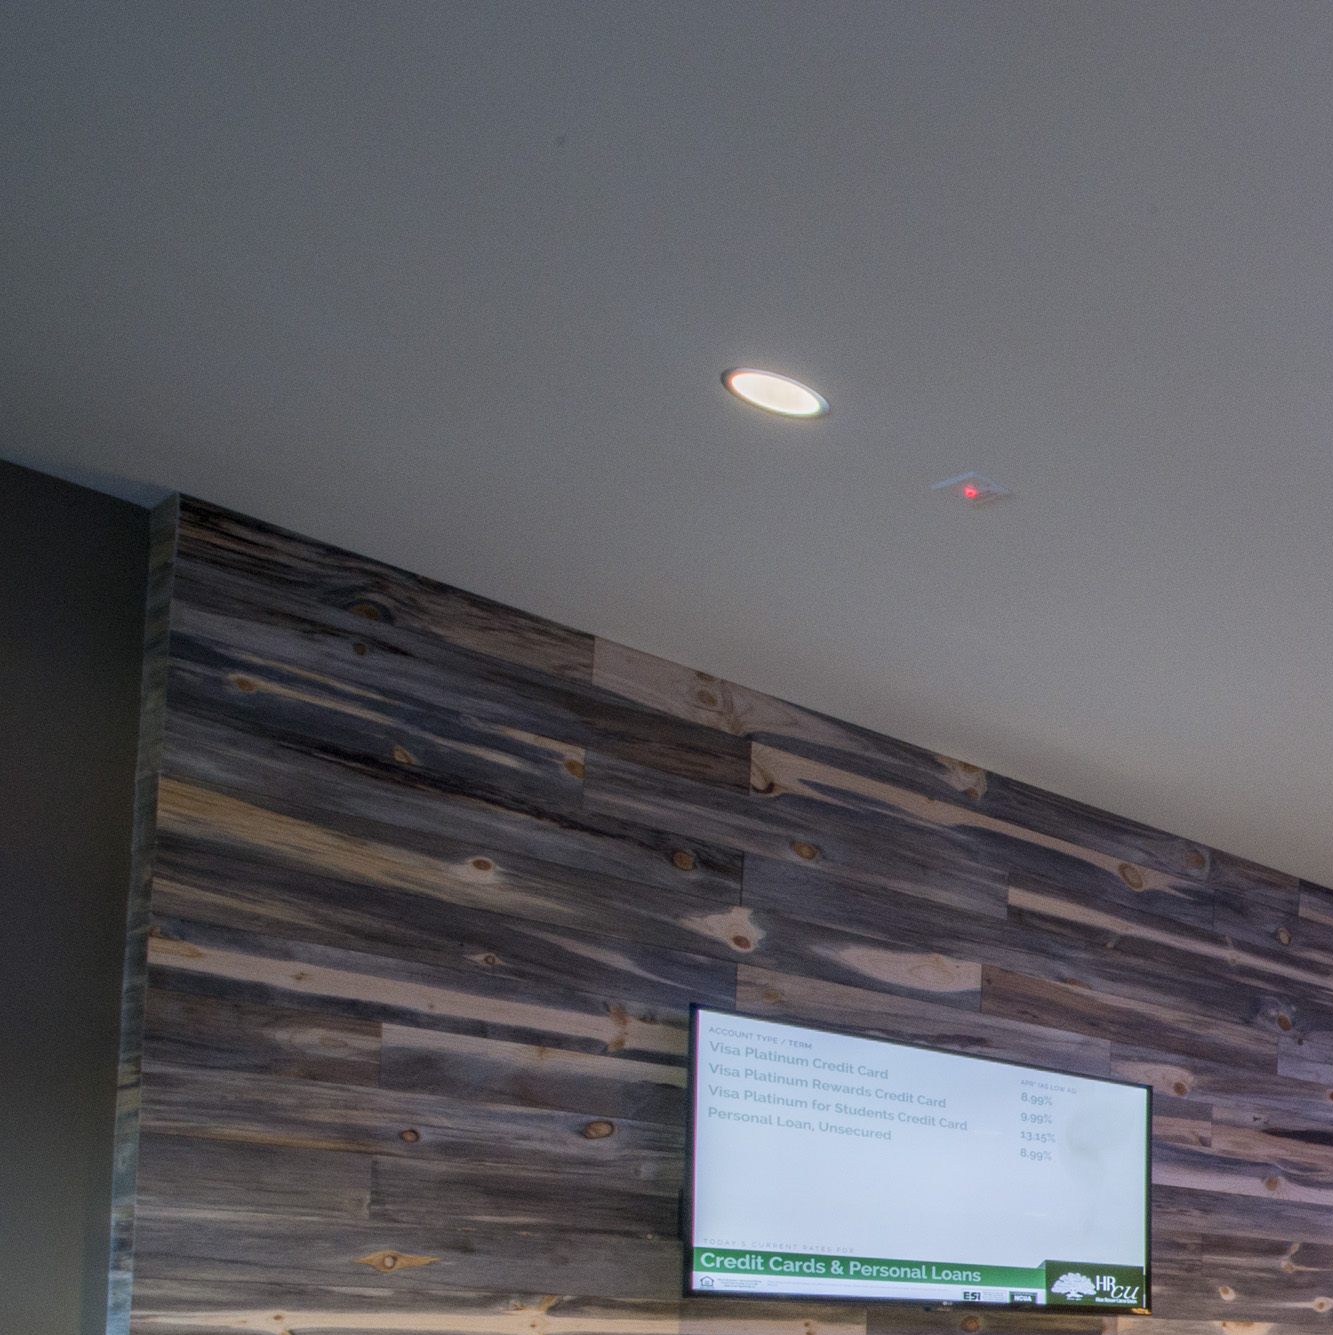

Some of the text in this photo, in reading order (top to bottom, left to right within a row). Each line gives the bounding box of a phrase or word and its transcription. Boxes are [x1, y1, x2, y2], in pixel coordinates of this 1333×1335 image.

[709, 1027, 753, 1040] ACCOUNT
[756, 1034, 778, 1045] TYPE
[789, 1040, 812, 1049] TERM
[710, 1041, 889, 1080] Visa Platinum Credit Card
[709, 1063, 946, 1108] Visa Platinum Rewards Credit Card
[709, 1084, 967, 1131] Visa Platinum for Students Credit Card
[1021, 1092, 1053, 1106] 8.99%
[708, 1106, 892, 1141] Personal Loan, Unsecured
[1021, 1112, 1052, 1124] 9.99%
[1020, 1131, 1056, 1143] 13.15%
[1020, 1148, 1052, 1161] 8.99%
[751, 1242, 798, 1250] CURRENT
[802, 1244, 832, 1253] RATES
[836, 1246, 855, 1254] FOR
[700, 1252, 981, 1281] Credit Cards & Personal Loans
